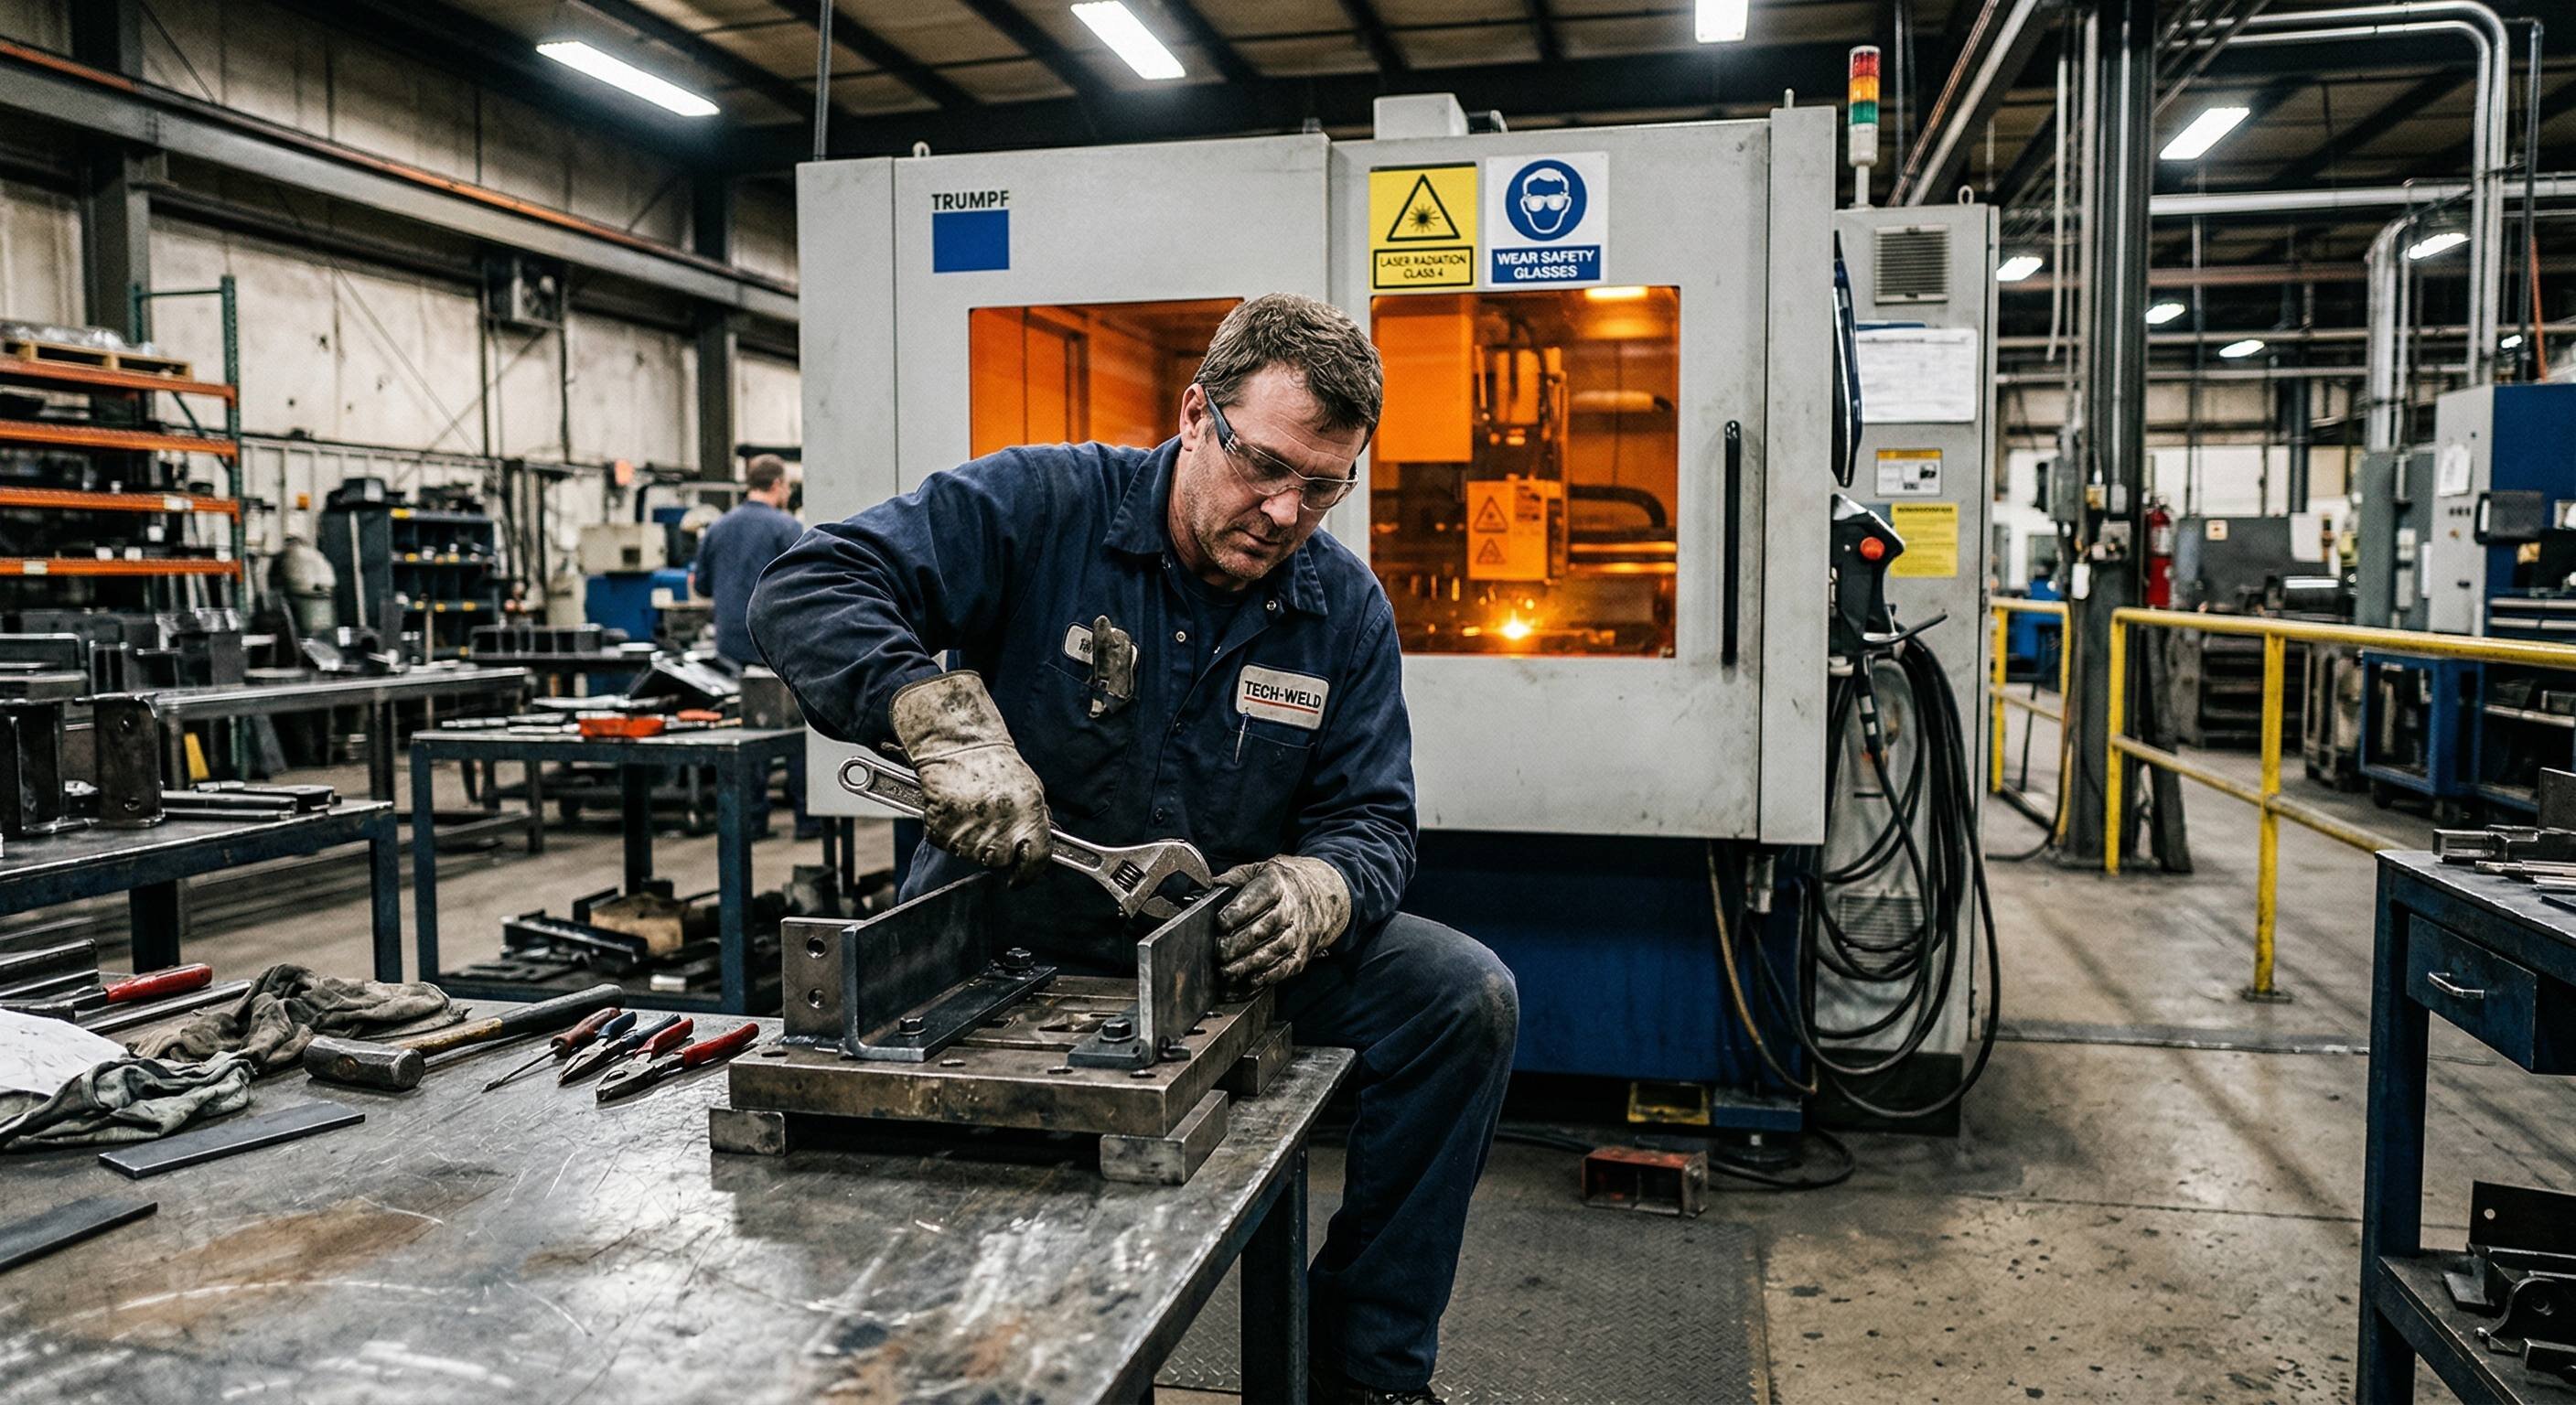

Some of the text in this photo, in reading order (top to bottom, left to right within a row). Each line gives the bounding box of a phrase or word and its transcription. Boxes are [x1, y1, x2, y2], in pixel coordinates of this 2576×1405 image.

[931, 190, 1010, 210] TRUMPF
[1497, 250, 1594, 265] WEAR SAFETY
[1403, 268, 1436, 279] CLASS
[1513, 265, 1578, 280] GLASSES
[1245, 680, 1322, 709] TECH-WELD
